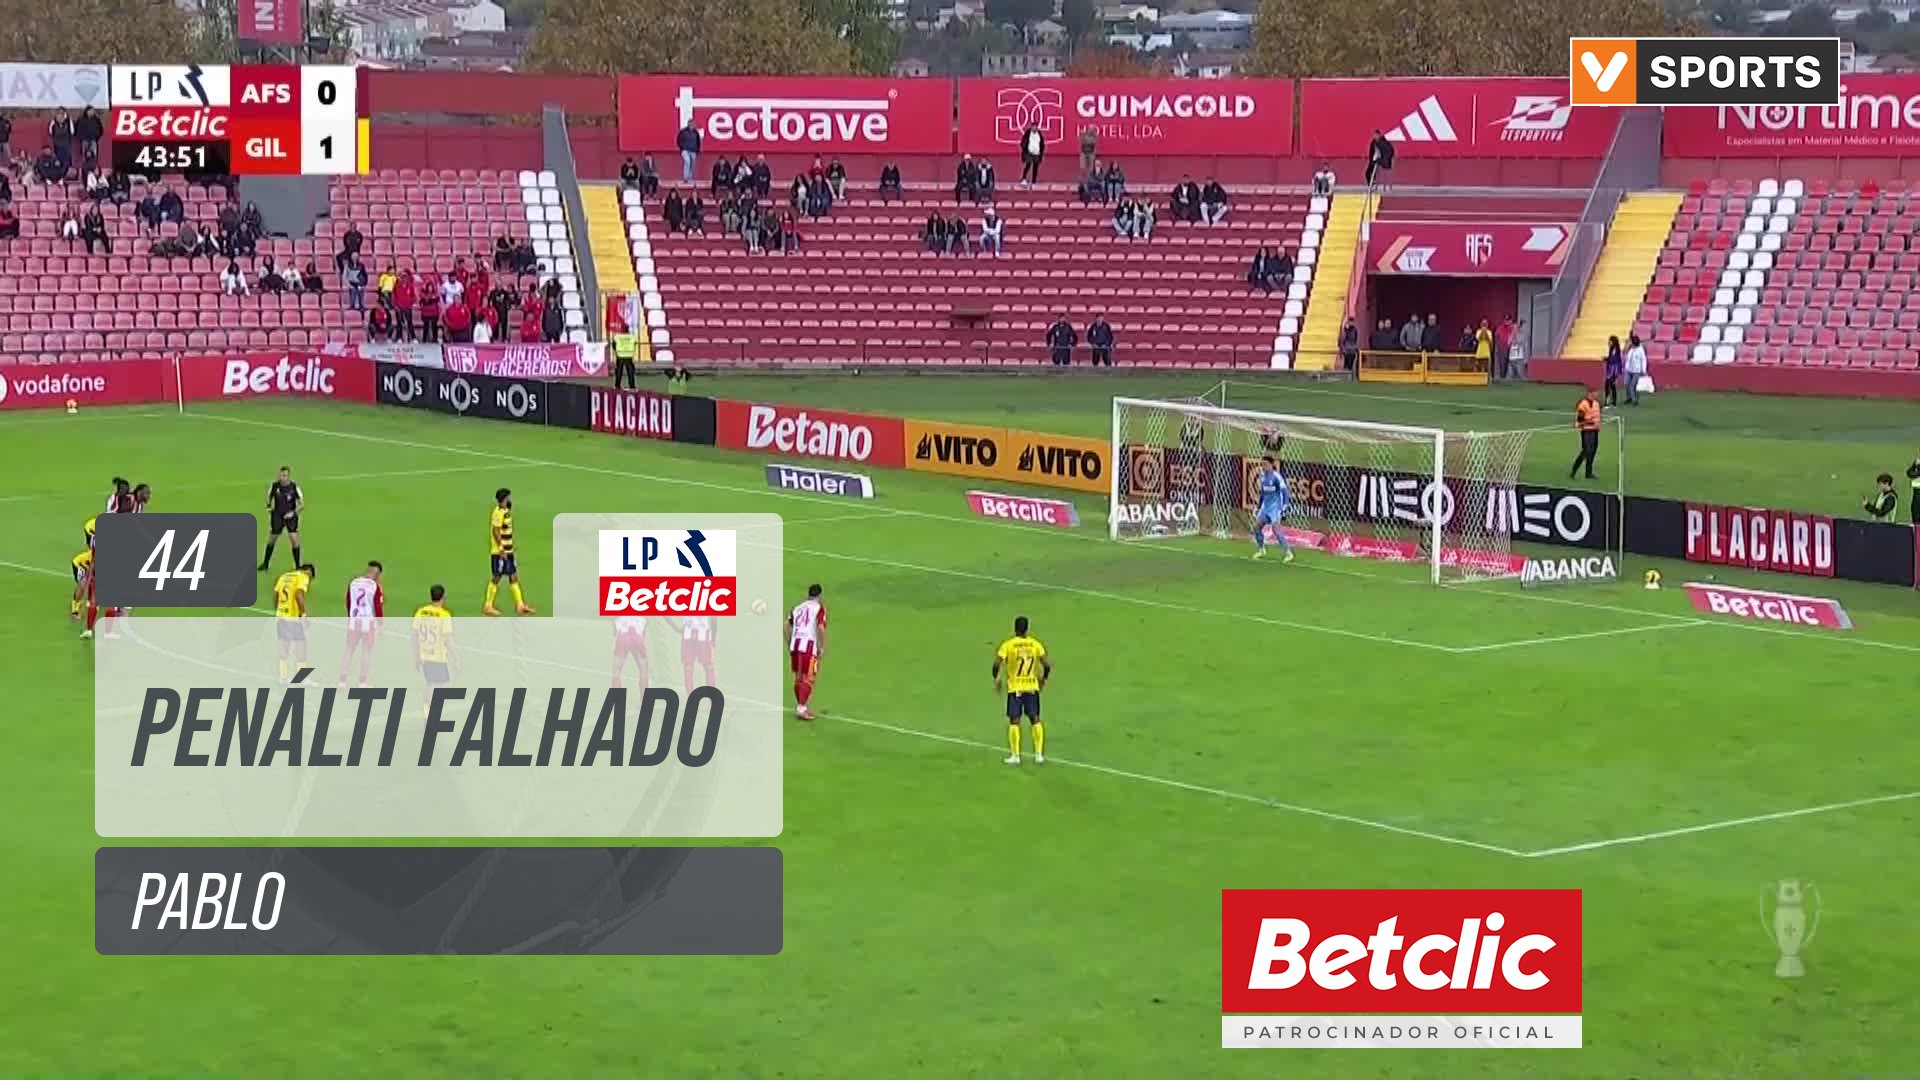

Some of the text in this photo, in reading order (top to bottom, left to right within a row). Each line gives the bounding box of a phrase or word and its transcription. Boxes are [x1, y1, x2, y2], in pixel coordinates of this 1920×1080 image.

[1077, 95, 1255, 118] GUIMAGOLD
[483, 359, 571, 377] VENCEREMOS!
[503, 346, 549, 361] JUNTOS
[13, 374, 105, 395] vodafone
[222, 356, 336, 394] Betclic
[383, 369, 424, 402] NOS
[439, 377, 480, 411] NOS
[496, 383, 537, 417] NOS
[591, 391, 672, 433] PLACARD
[747, 405, 873, 461] Betano
[933, 434, 997, 467] VITO
[1035, 446, 1101, 480] VITO
[981, 497, 1056, 524] Betclic
[1117, 502, 1199, 524] ABANCA
[1485, 487, 1591, 542] MEO
[1687, 510, 1833, 569] PLACARD
[1529, 556, 1616, 580] ABANCA
[356, 588, 366, 606] 2
[1706, 591, 1820, 626] Betclic
